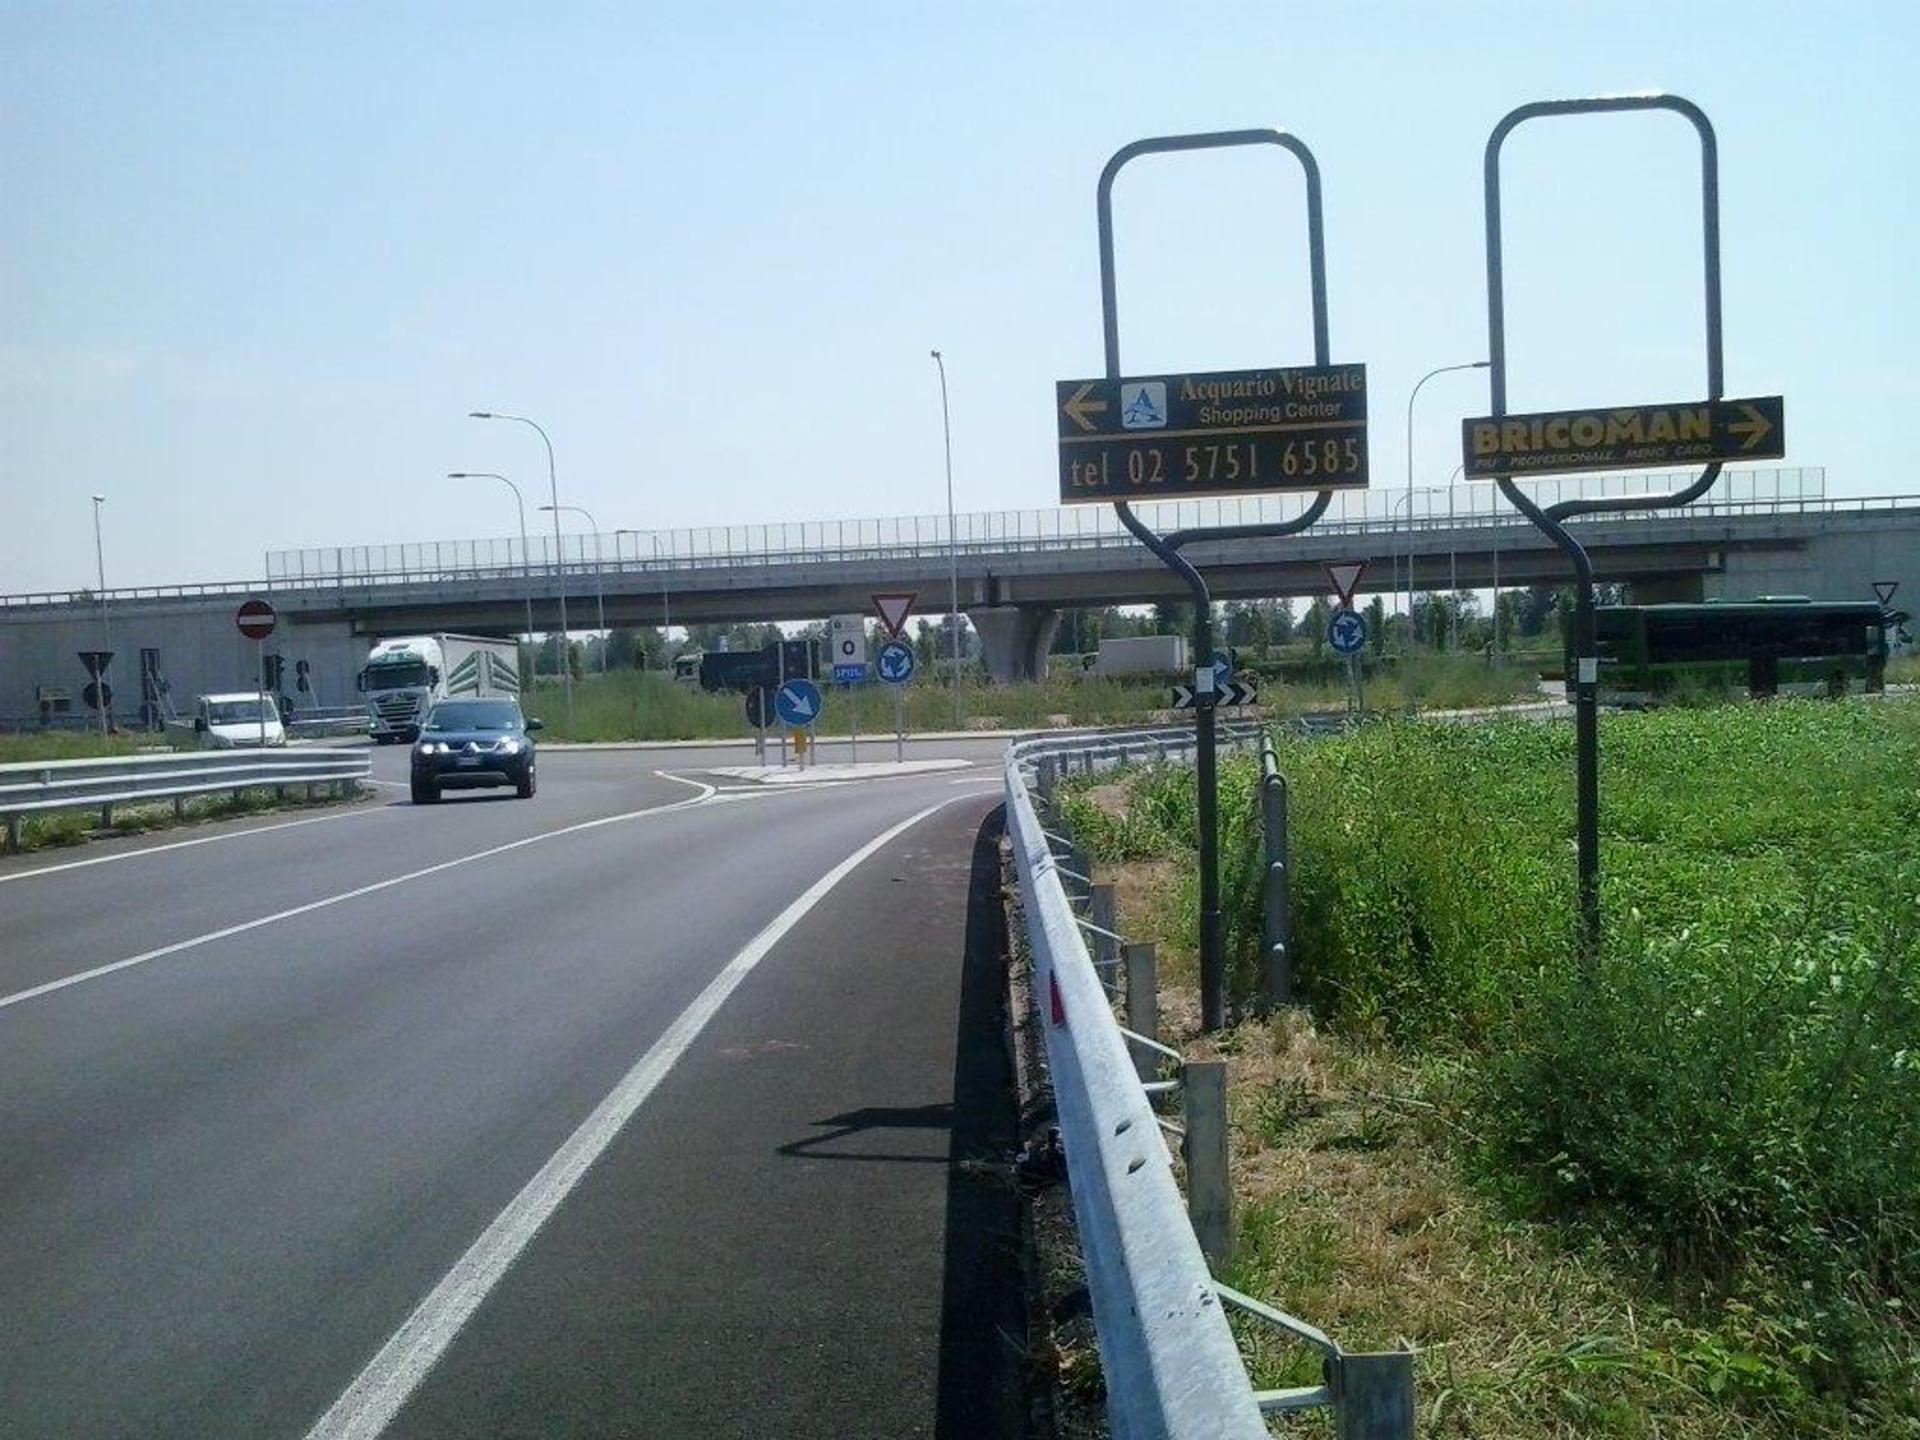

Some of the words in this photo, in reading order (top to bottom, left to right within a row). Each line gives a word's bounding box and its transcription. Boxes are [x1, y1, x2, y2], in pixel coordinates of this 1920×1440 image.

[1180, 374, 1276, 402] Acquario
[1279, 370, 1364, 400] Vignate
[1199, 403, 1281, 425] Shopping
[1286, 401, 1342, 419] Center
[1472, 408, 1712, 455] BRICOMAN
[1070, 449, 1109, 487] tel
[1128, 448, 1165, 485] 02
[1185, 443, 1258, 482] 5751
[1282, 437, 1360, 478] 6585
